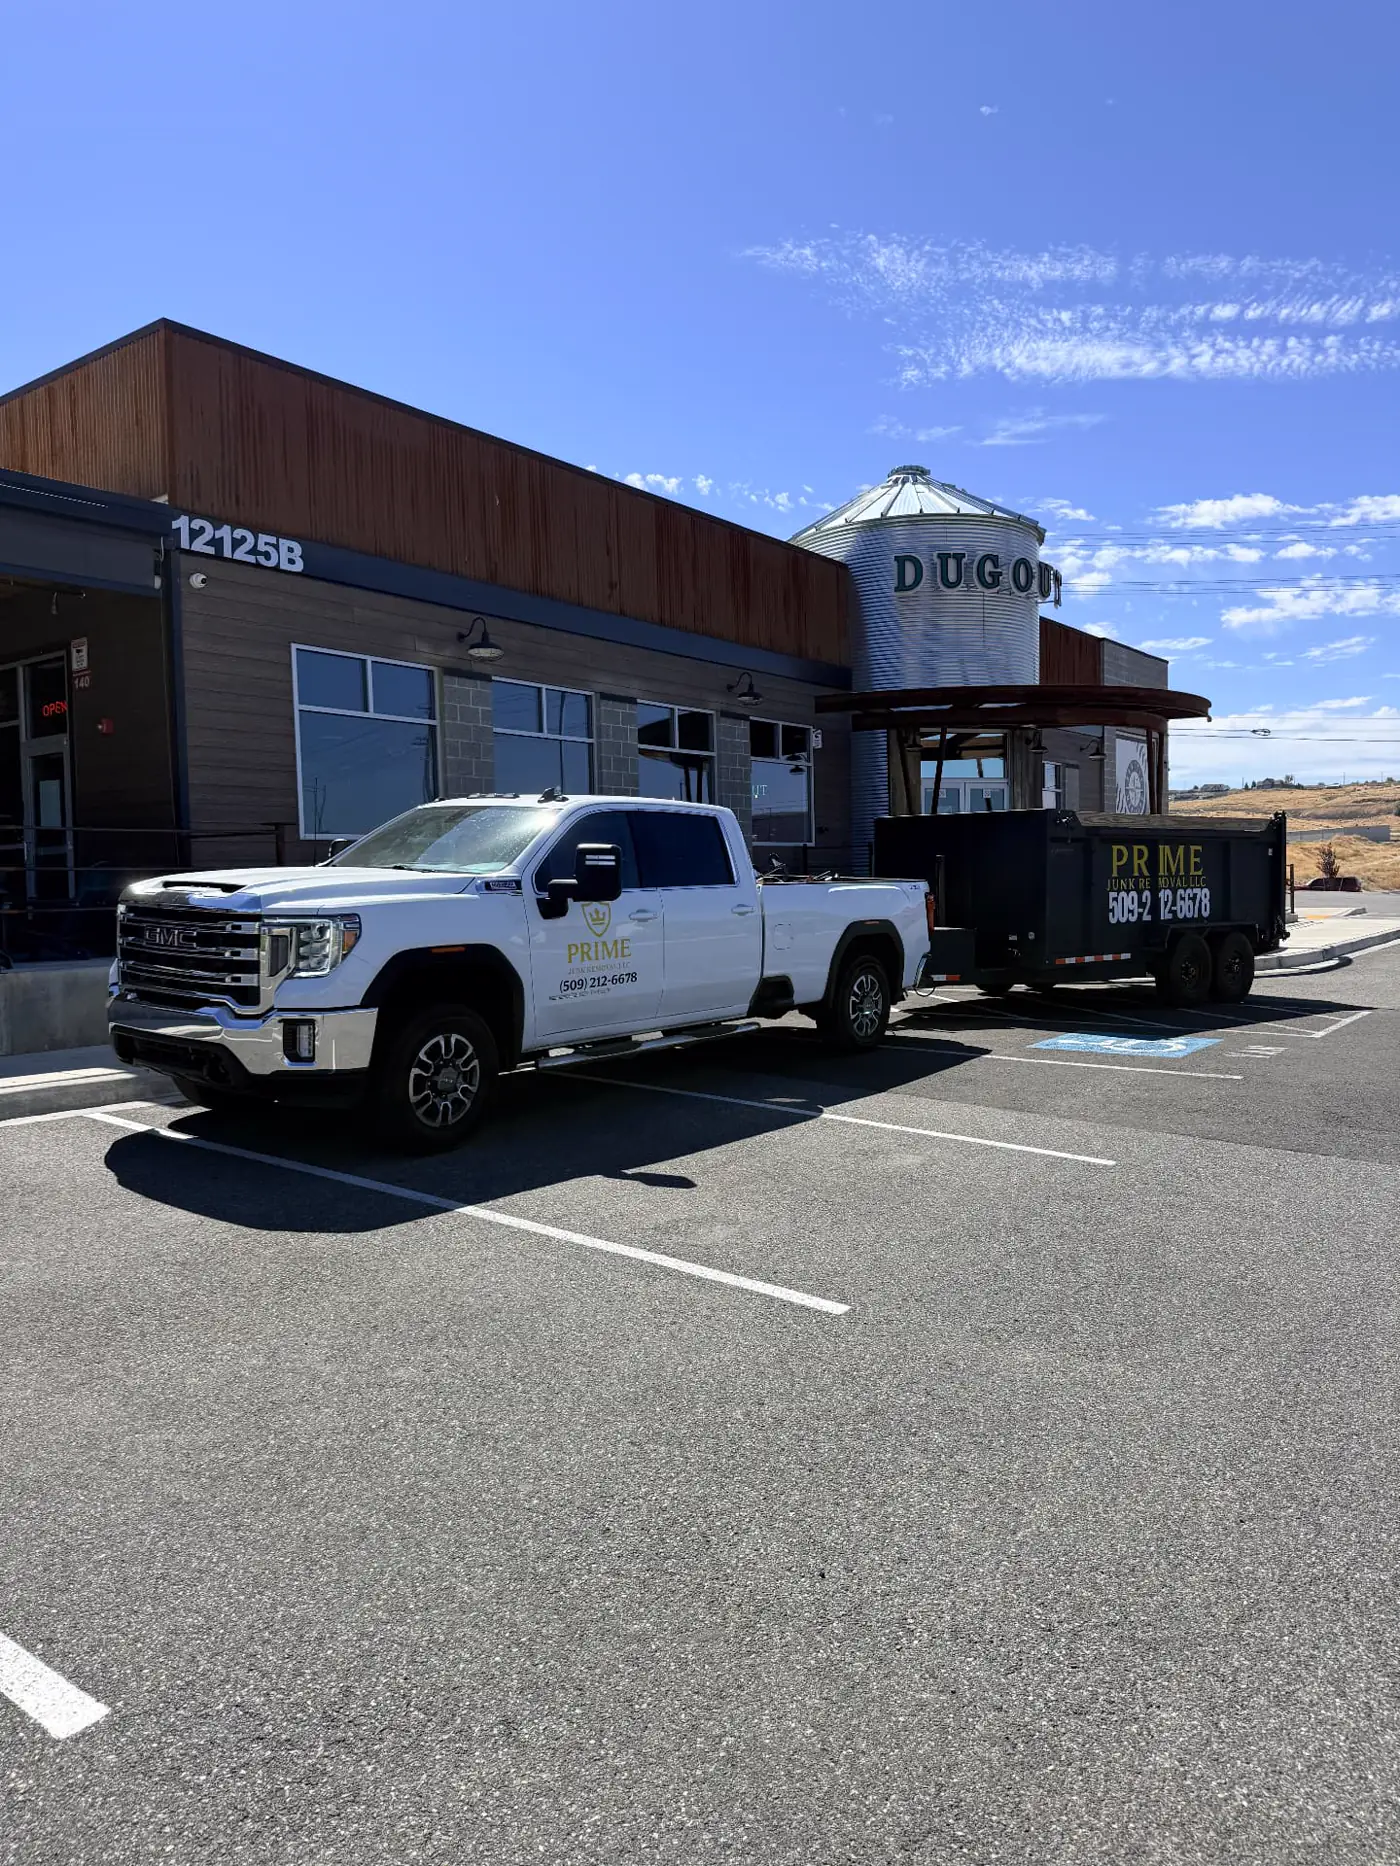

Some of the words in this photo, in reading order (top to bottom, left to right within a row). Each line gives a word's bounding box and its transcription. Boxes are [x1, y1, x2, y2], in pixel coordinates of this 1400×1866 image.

[172, 515, 304, 573] 12125B
[894, 552, 1062, 608] DUGOUT
[74, 676, 90, 689] 140
[1107, 878, 1135, 891] JUNK
[1190, 876, 1206, 887] LLC
[145, 927, 197, 948] GMC
[567, 938, 632, 963] PRIME
[560, 977, 587, 993] (509)
[590, 972, 638, 988] 212-6678
